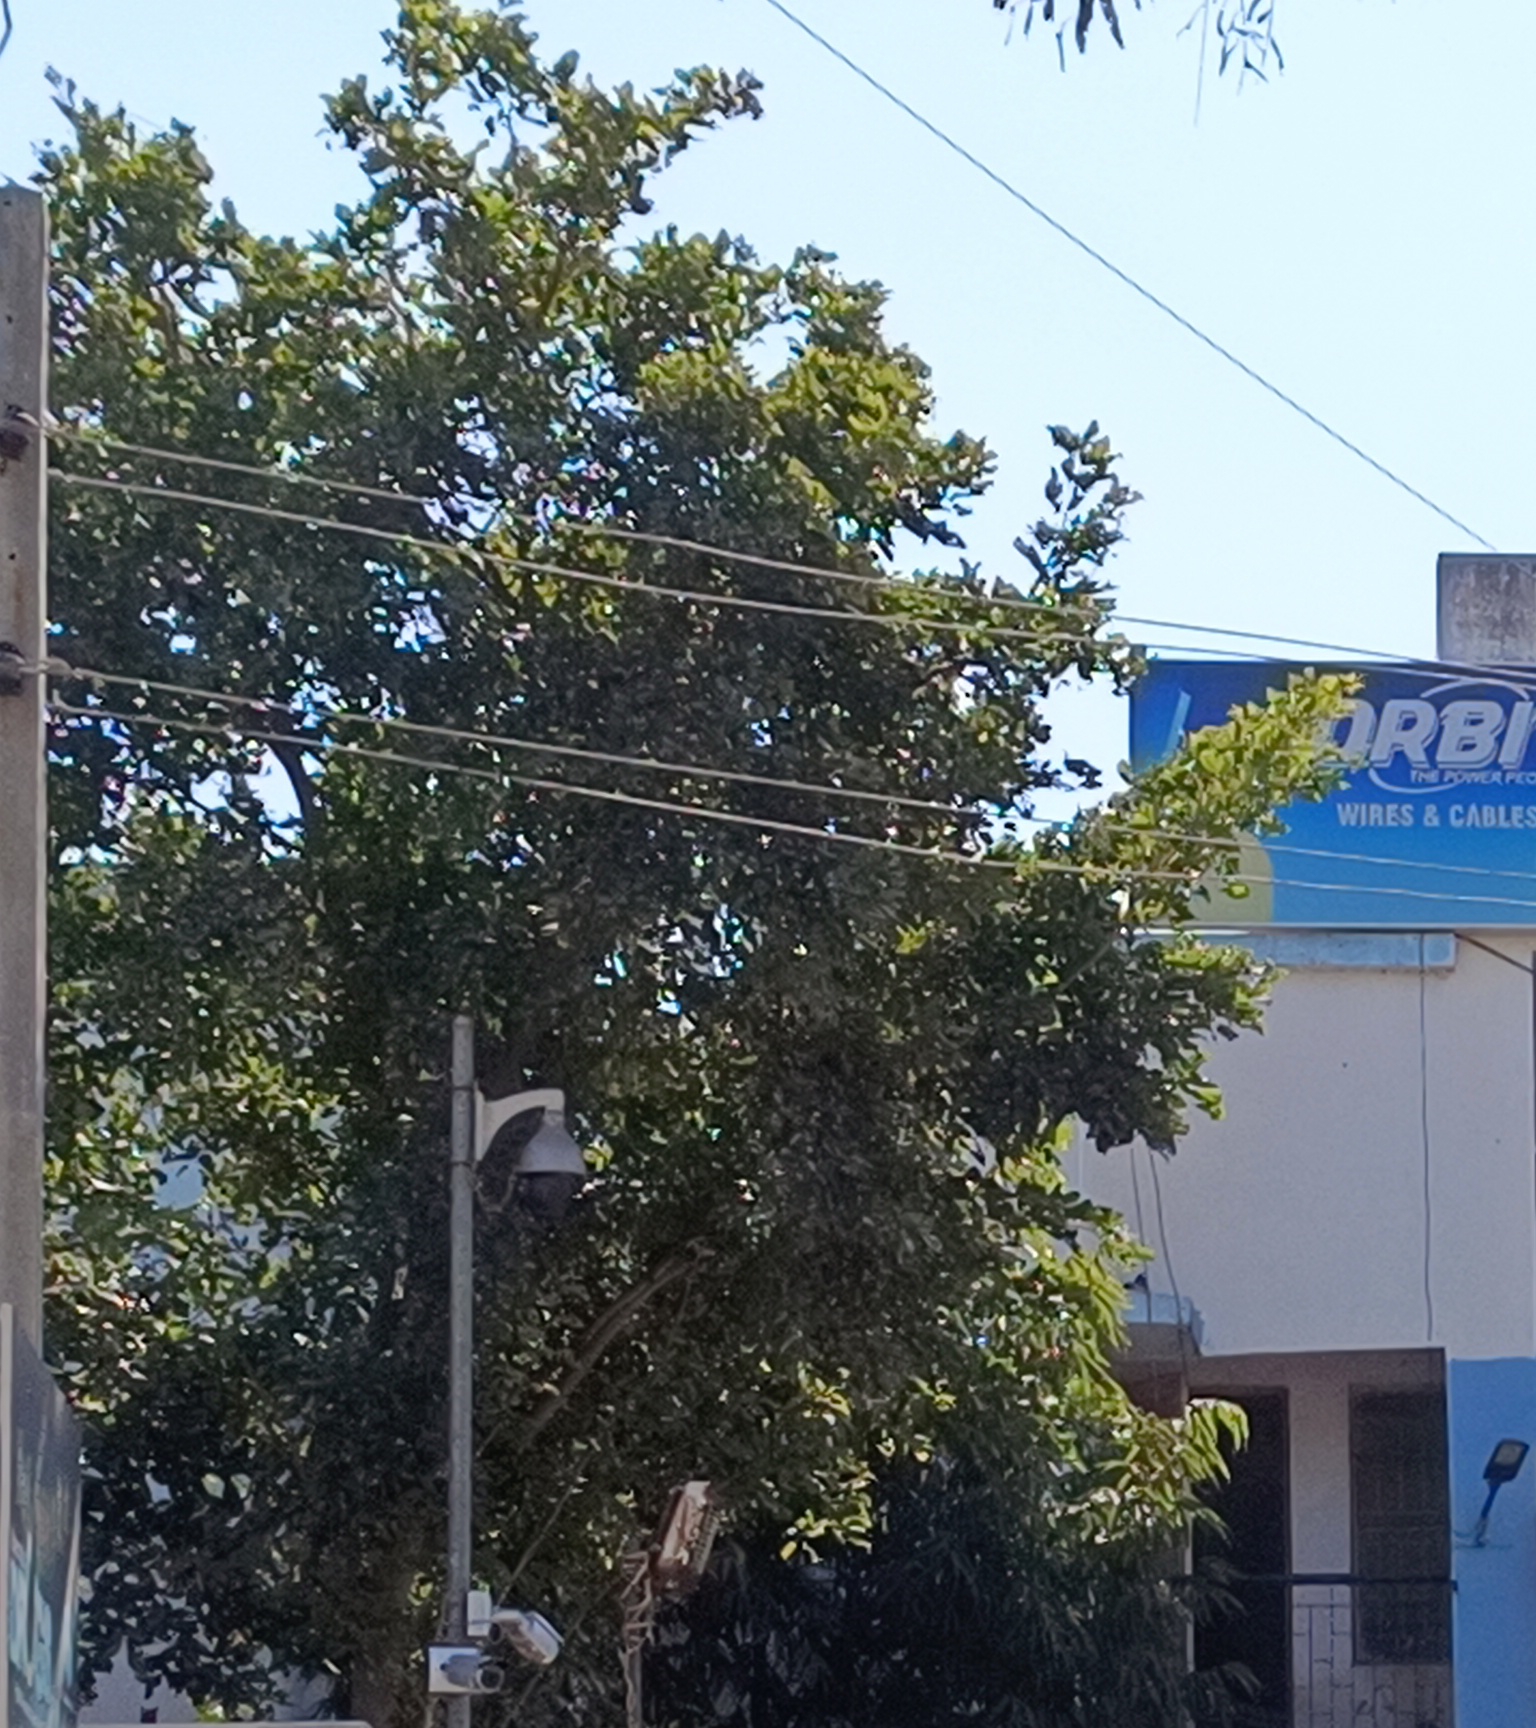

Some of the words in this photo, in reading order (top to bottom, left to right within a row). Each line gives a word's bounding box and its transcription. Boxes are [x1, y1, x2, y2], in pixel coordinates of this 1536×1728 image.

[1411, 770, 1439, 784] THE
[1443, 770, 1502, 786] POWER
[1336, 802, 1414, 828] WIRES
[1424, 803, 1440, 828] &
